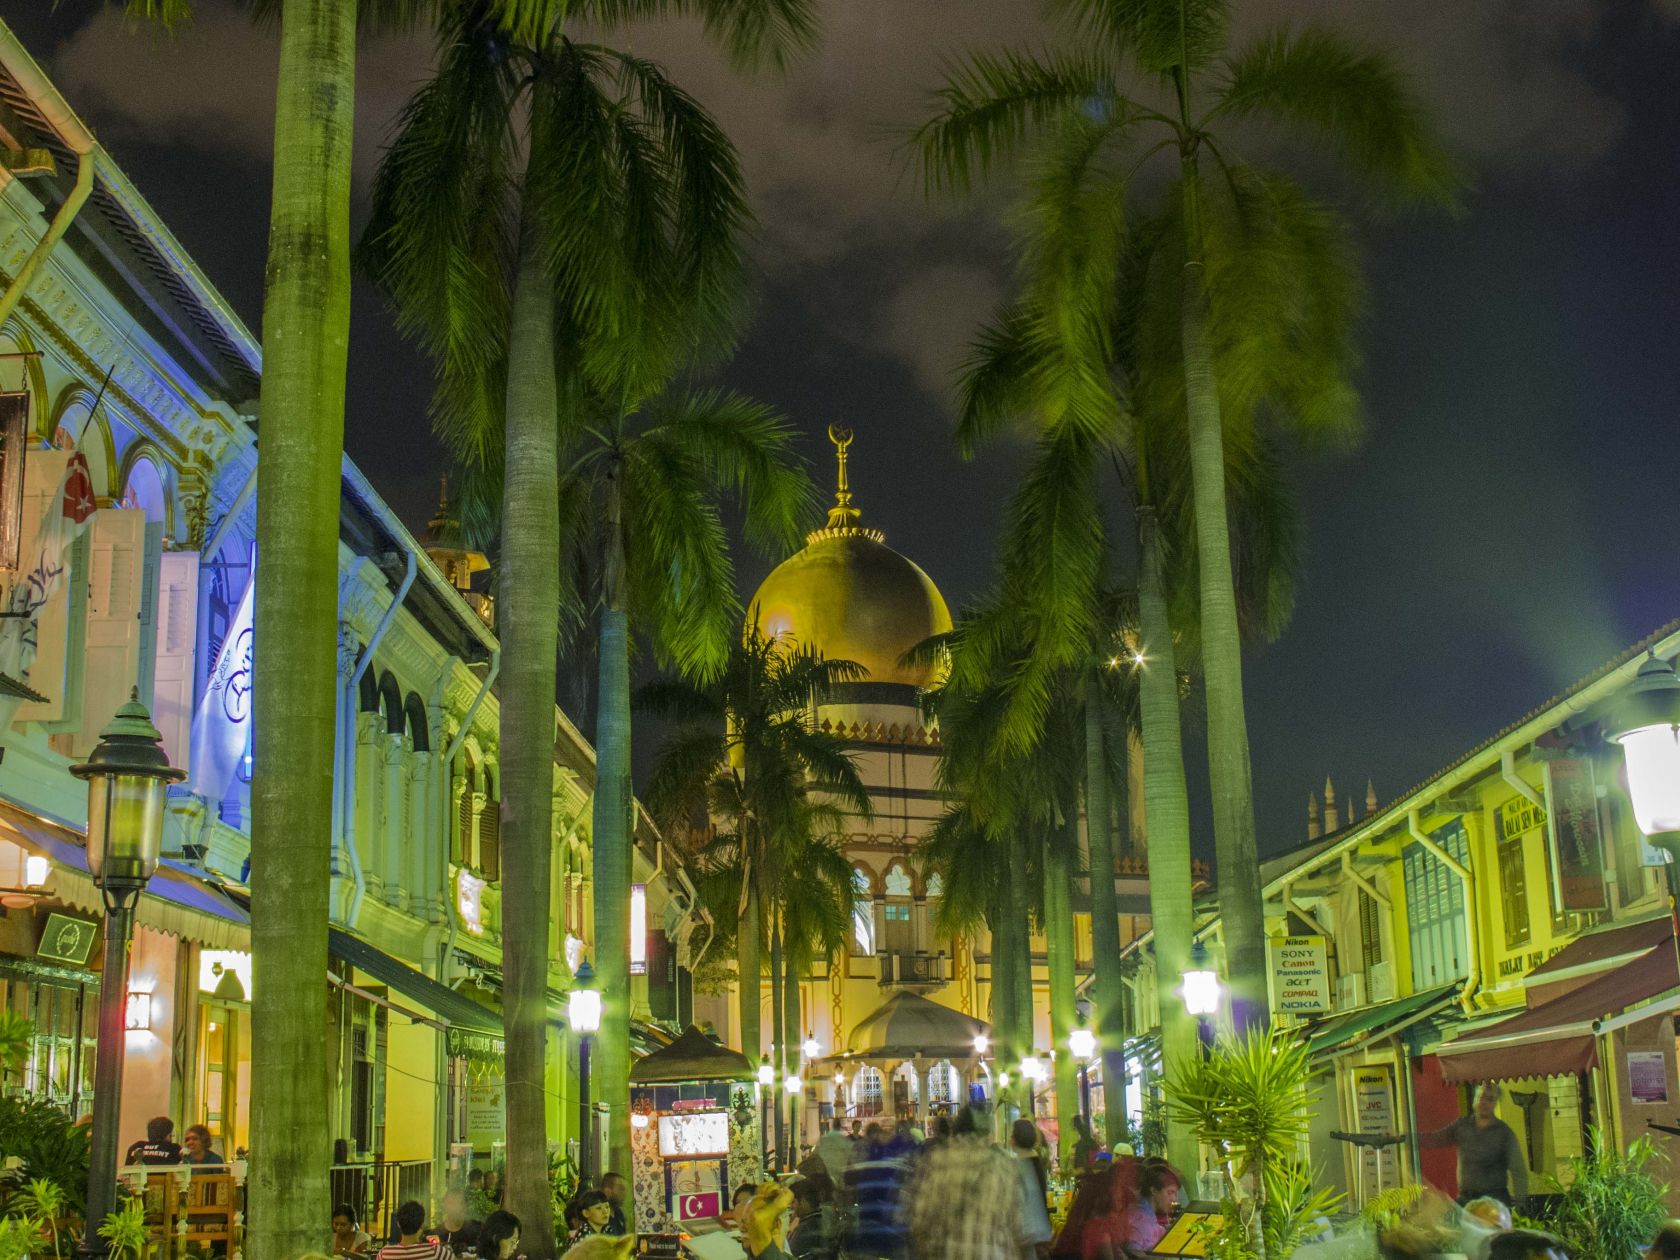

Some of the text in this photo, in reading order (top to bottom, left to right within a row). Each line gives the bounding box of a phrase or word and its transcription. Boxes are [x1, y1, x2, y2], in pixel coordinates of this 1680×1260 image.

[1281, 950, 1314, 958] SONY
[1282, 960, 1315, 968] Canon
[1277, 968, 1321, 976] Panasonic
[1282, 990, 1319, 998] COMPAQ
[1281, 1001, 1321, 1009] NOKIA
[1366, 1101, 1382, 1110] JVC
